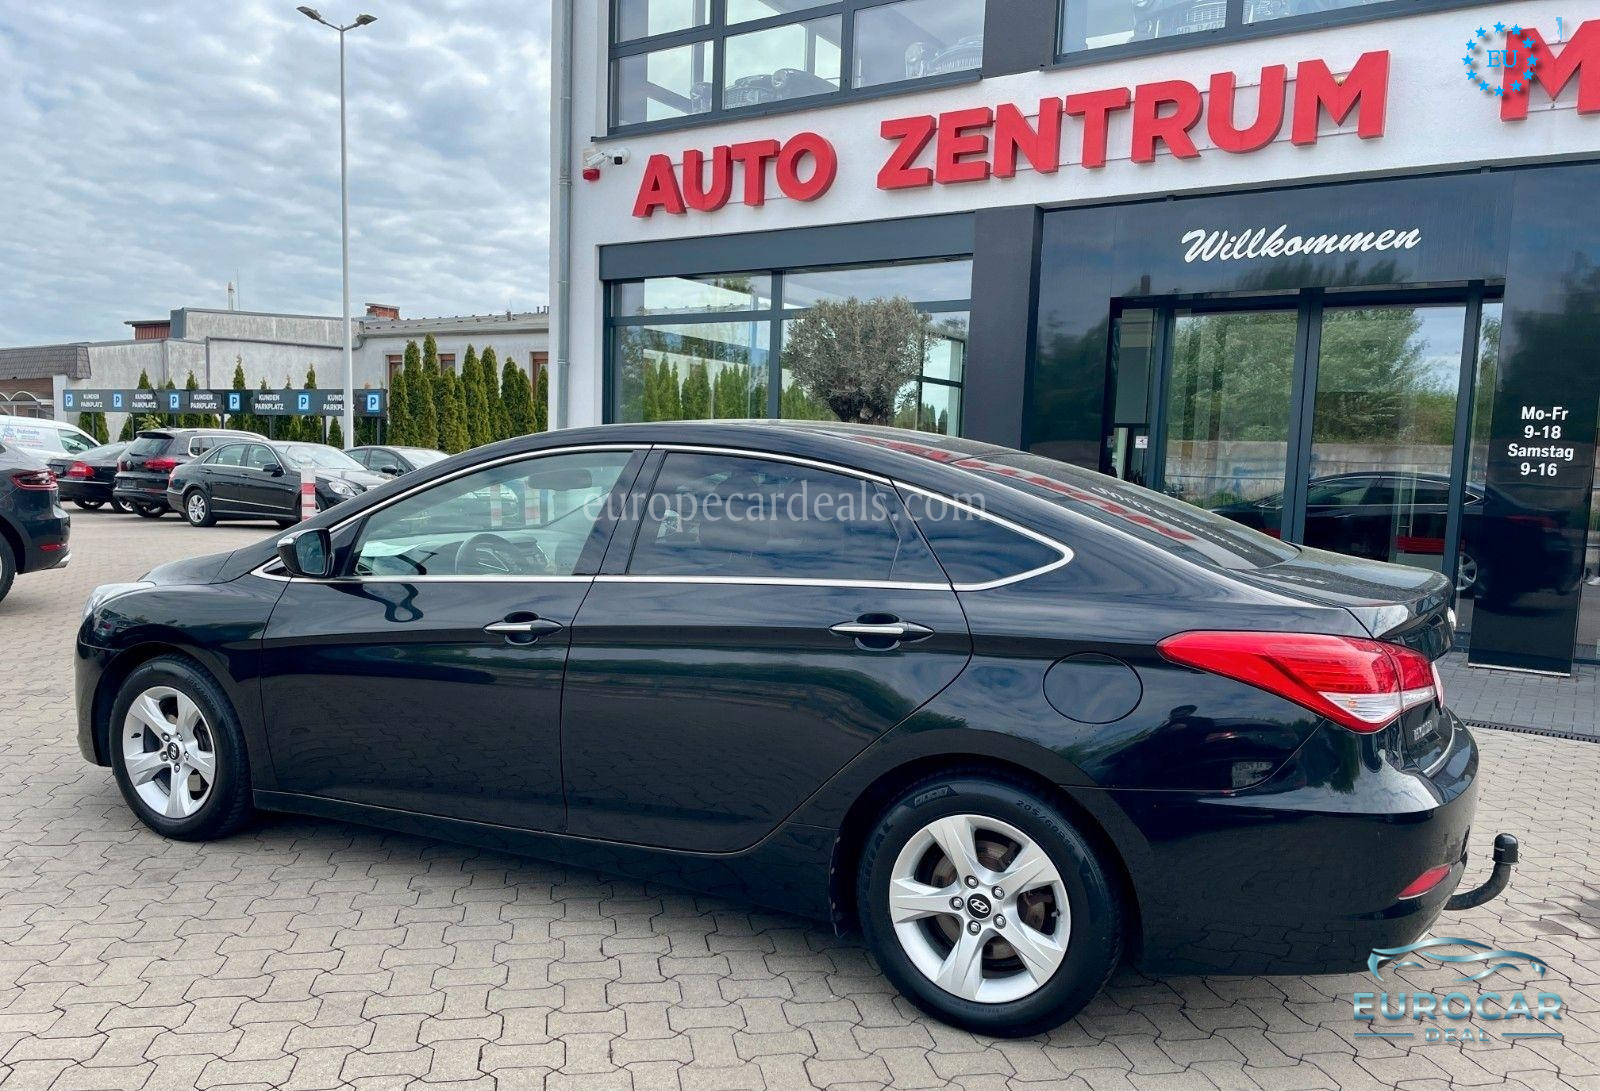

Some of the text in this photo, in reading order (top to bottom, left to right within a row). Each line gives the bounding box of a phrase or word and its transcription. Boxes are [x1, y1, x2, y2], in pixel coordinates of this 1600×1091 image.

[632, 131, 837, 218] AUTO
[877, 50, 1390, 191] ZENTRUM
[1181, 224, 1422, 263] Willkommen
[131, 401, 157, 409] PARKPLATZ
[1521, 406, 1568, 421] Mo-Fr
[1524, 425, 1562, 439] 9-18
[1507, 443, 1574, 461] Samstag
[1520, 463, 1557, 477] 9-16
